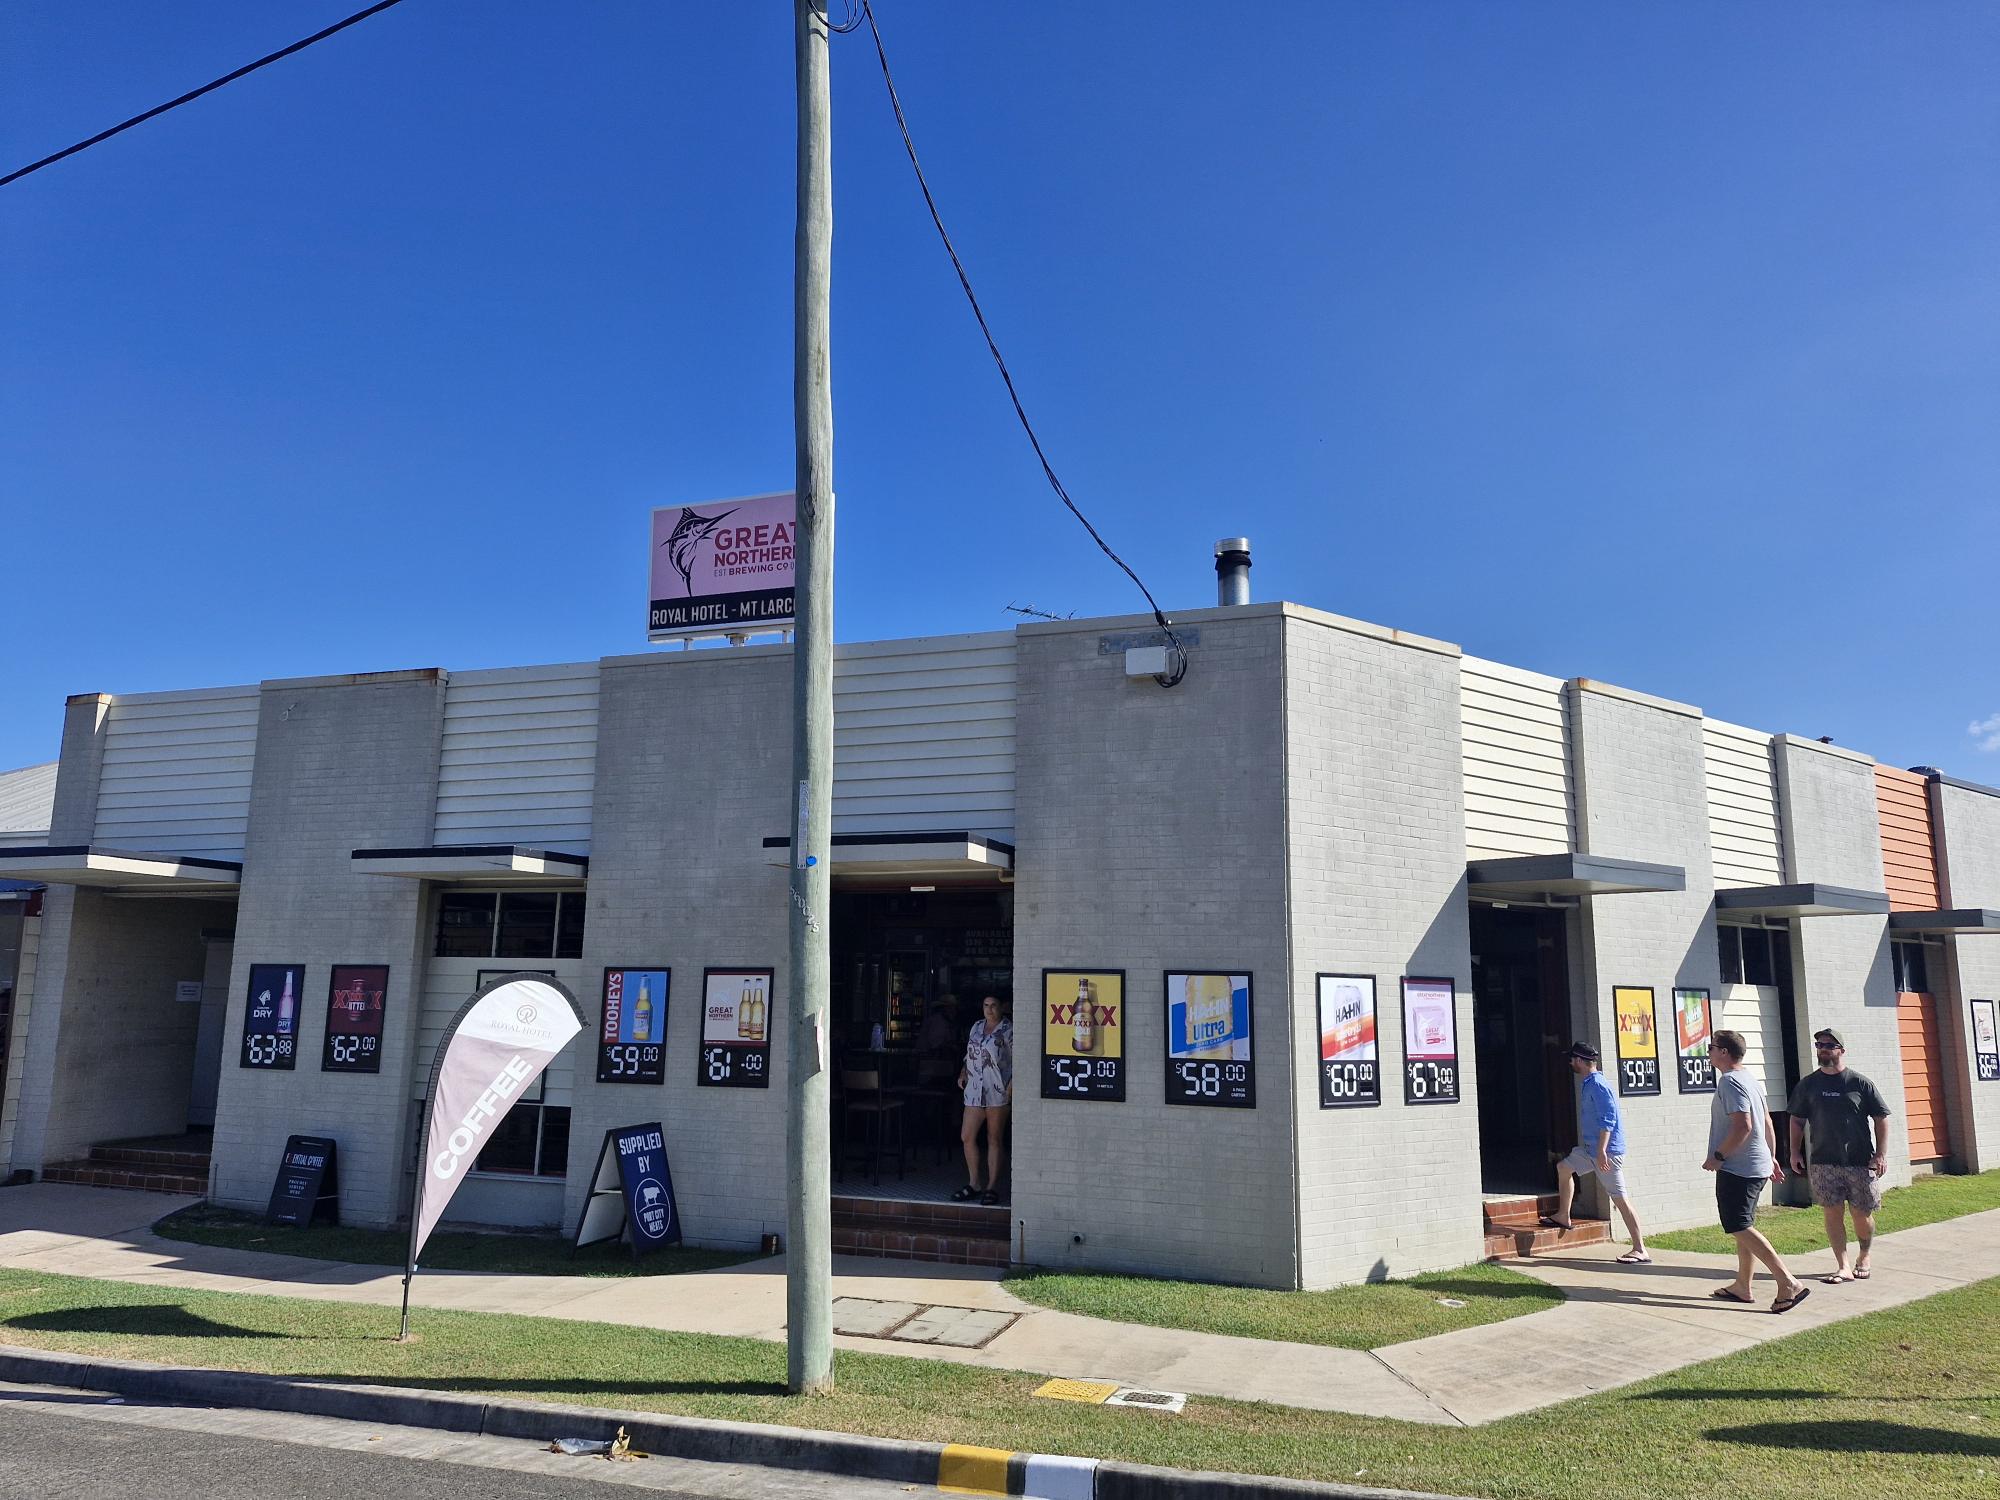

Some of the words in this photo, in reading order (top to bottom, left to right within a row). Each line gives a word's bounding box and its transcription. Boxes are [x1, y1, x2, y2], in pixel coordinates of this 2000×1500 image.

[728, 563, 774, 576] BREWING
[652, 607, 688, 626] ROYAL
[691, 603, 728, 622] HOTEL
[739, 600, 758, 618] MT
[332, 989, 383, 1009] XX
[604, 973, 622, 1040] TOOHEYS
[1335, 1000, 1361, 1024] HAHN
[253, 1009, 273, 1018] DRY
[1619, 1013, 1653, 1032] XX
[491, 1019, 520, 1033] ROYAL
[521, 1025, 553, 1039] HOTEL
[1193, 1019, 1225, 1041] Ultra
[331, 1036, 376, 1062] $62.00
[606, 1045, 659, 1075] $59.00
[704, 1048, 763, 1081] $61.00
[1050, 1058, 1116, 1092] $52.00
[1175, 1062, 1246, 1096] $58.00
[1326, 1063, 1373, 1097] $60.00
[1408, 1062, 1453, 1098] $67.00
[433, 1054, 533, 1180] COFFEE
[618, 1132, 662, 1155] SUPPLIED
[638, 1155, 650, 1173] BY
